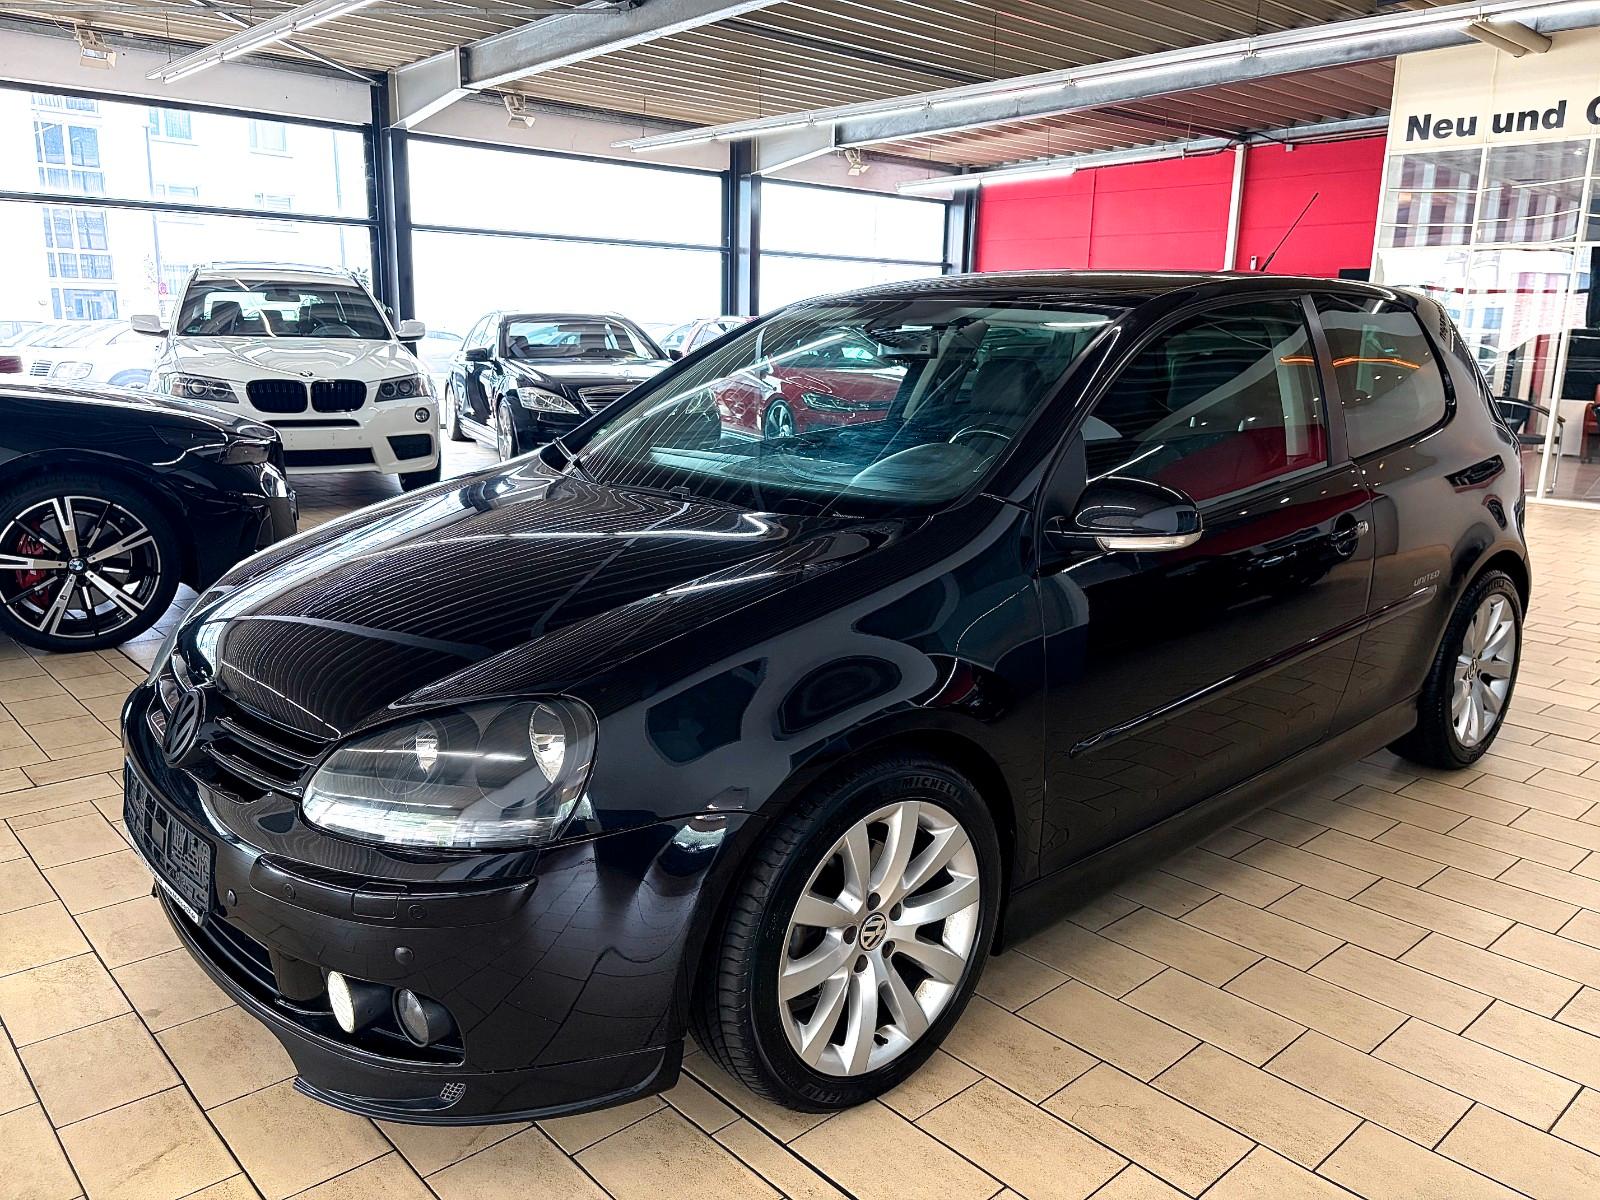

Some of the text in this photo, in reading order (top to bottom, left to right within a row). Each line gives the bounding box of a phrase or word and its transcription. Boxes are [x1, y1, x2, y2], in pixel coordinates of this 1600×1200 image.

[1406, 113, 1478, 142] Neu
[1492, 99, 1568, 134] und
[902, 776, 963, 800] MICHELI
